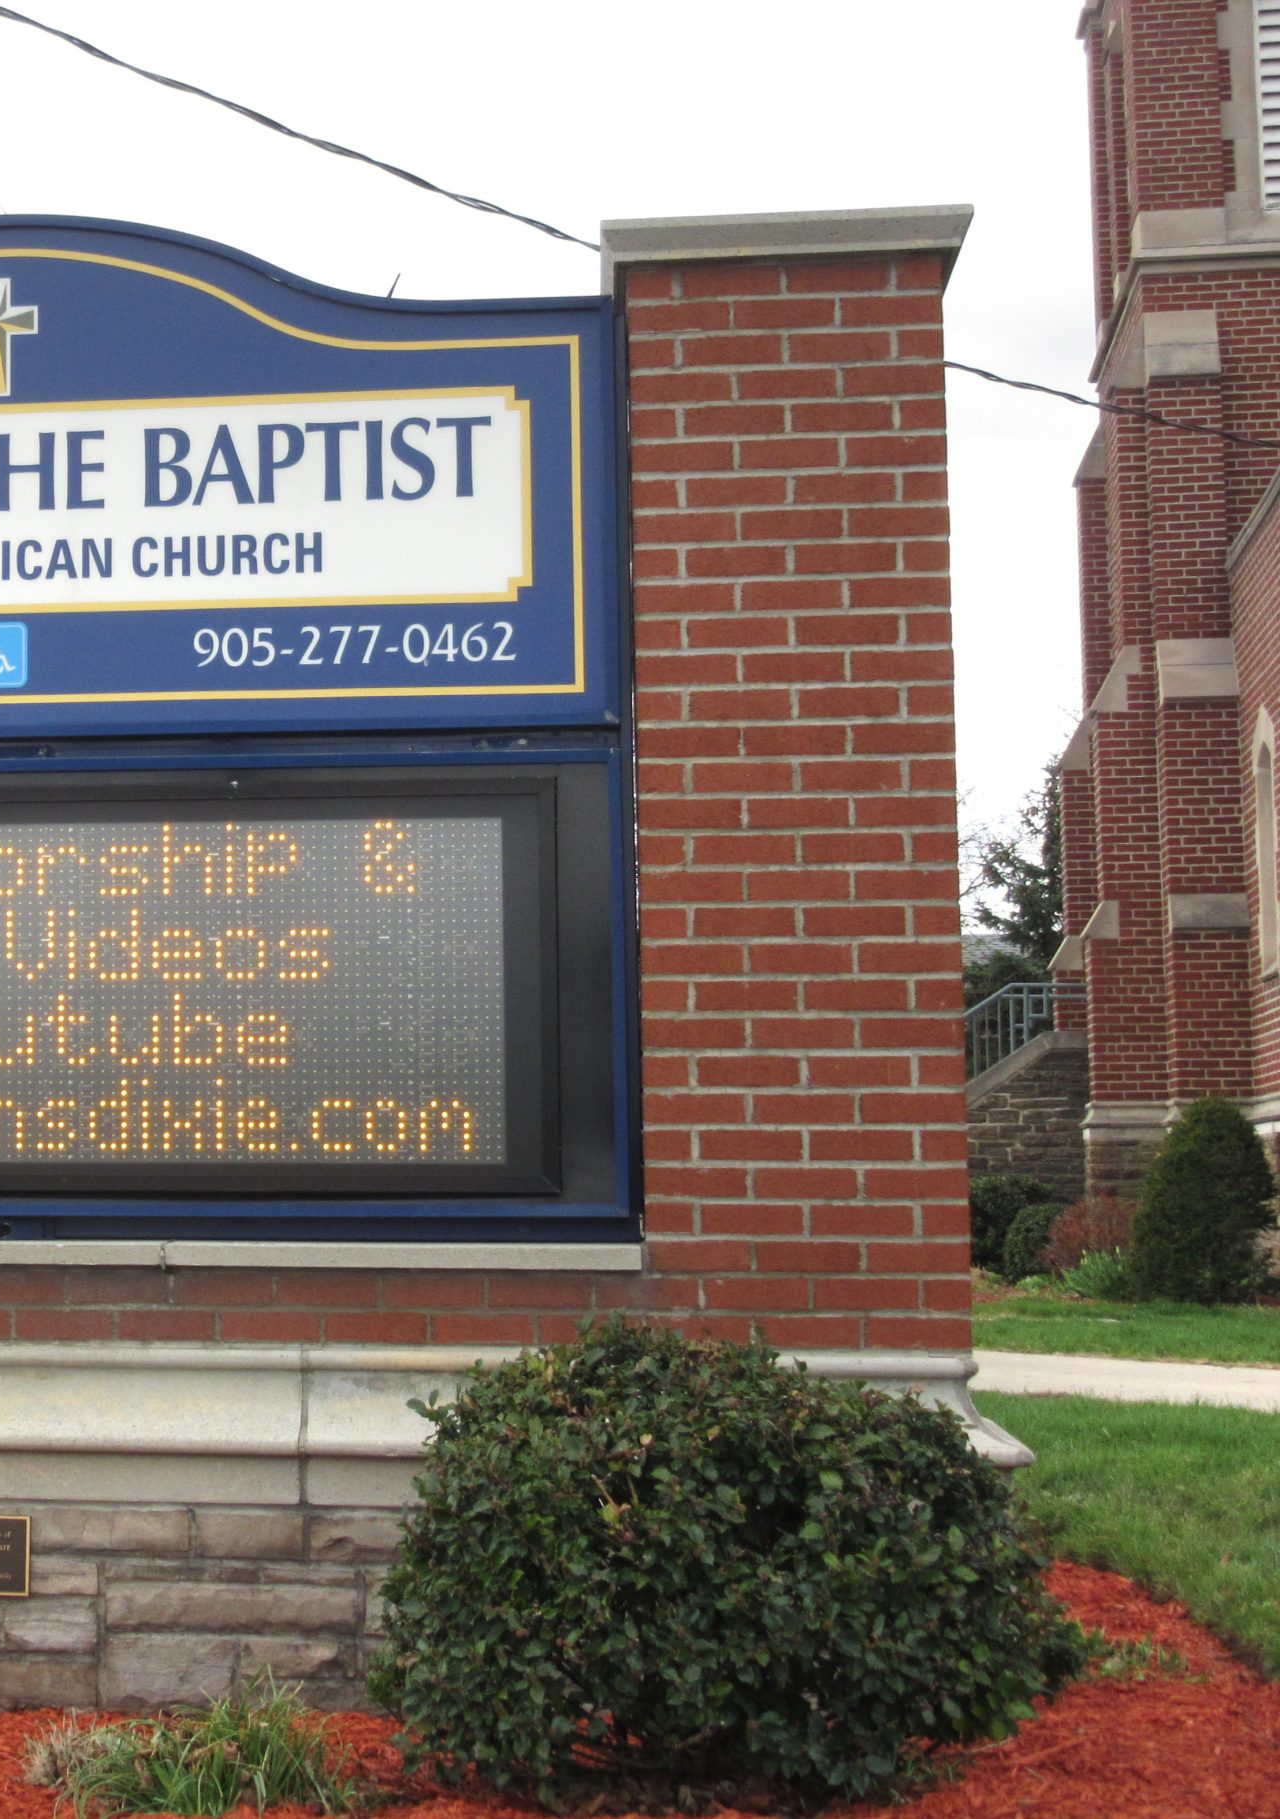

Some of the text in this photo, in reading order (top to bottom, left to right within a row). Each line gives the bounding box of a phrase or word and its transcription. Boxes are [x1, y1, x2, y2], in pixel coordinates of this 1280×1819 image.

[143, 415, 492, 508] BAPTIST
[131, 531, 324, 578] CHURCH
[192, 621, 517, 668] 905-277-0462
[363, 820, 416, 894] &
[6, 907, 330, 981] Videos
